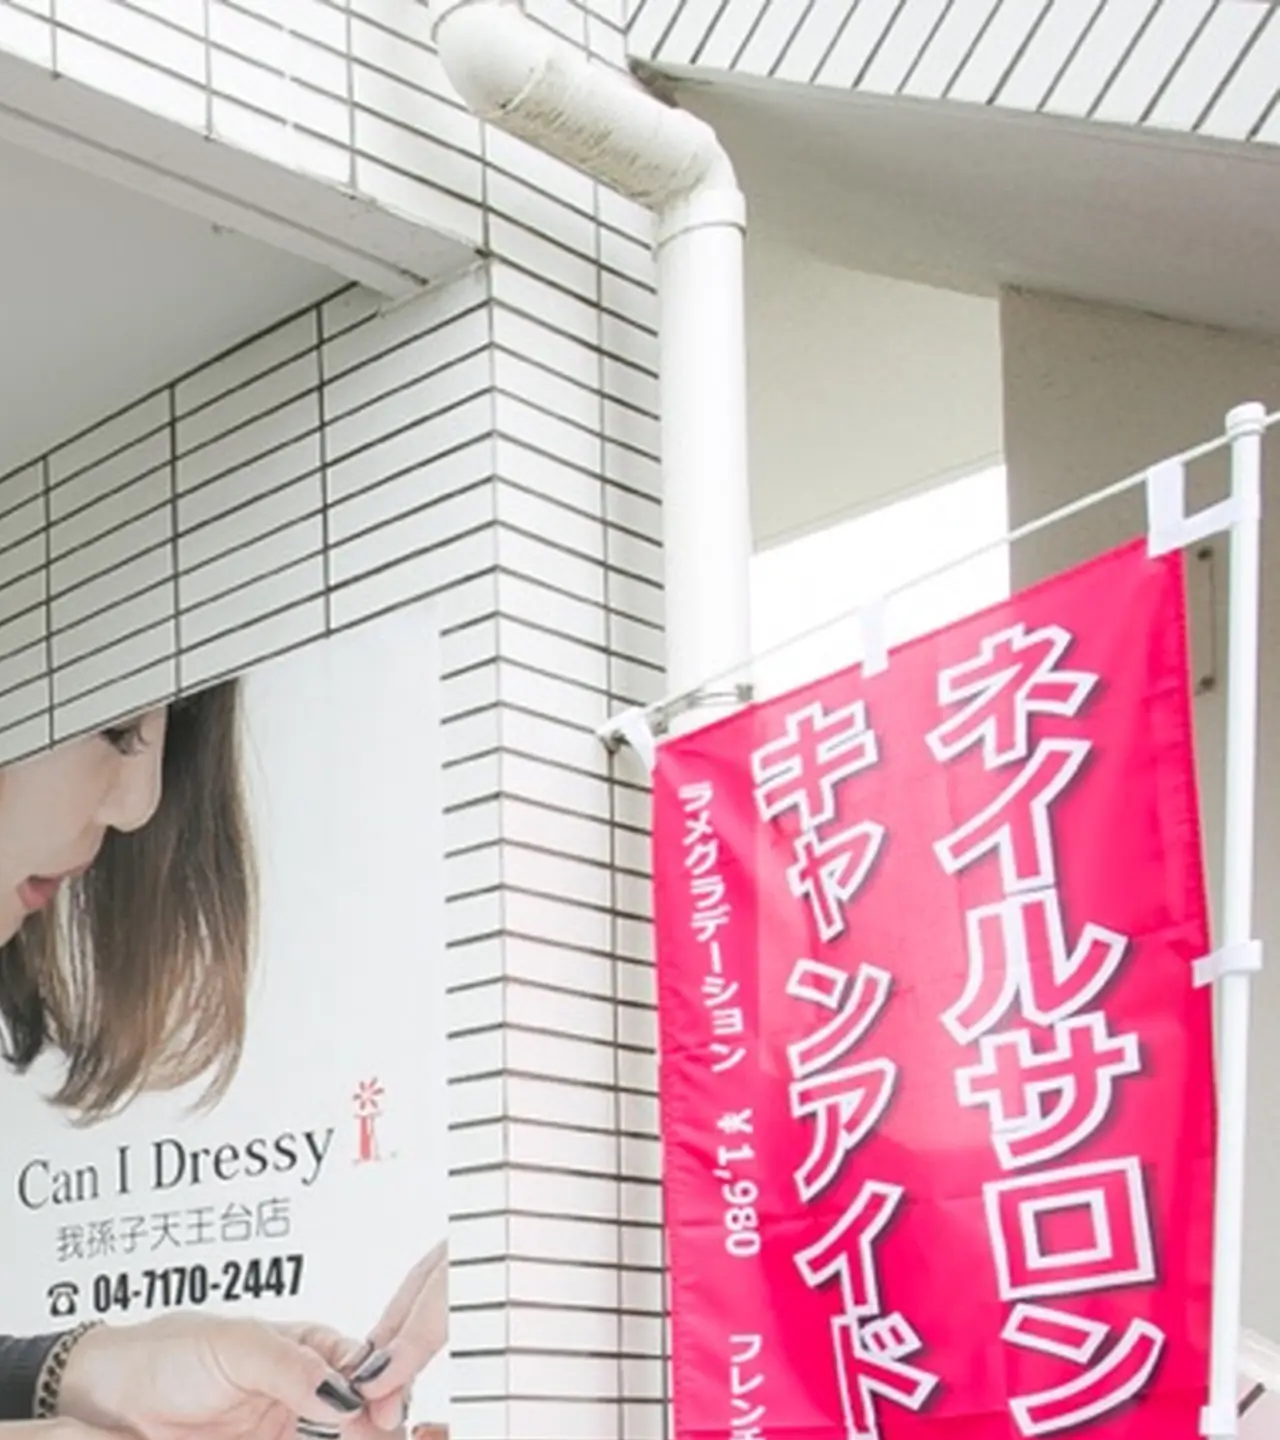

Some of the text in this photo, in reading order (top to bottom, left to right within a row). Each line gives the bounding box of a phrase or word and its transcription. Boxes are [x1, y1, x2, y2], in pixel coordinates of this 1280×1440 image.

[679, 780, 746, 1073] ラメグラデーション
[926, 621, 1165, 1438] ネイルサロン
[17, 1126, 336, 1211] Can I Dressy
[55, 1197, 292, 1263] 我孫子天王台店
[92, 1254, 305, 1314] 04-7170-2447
